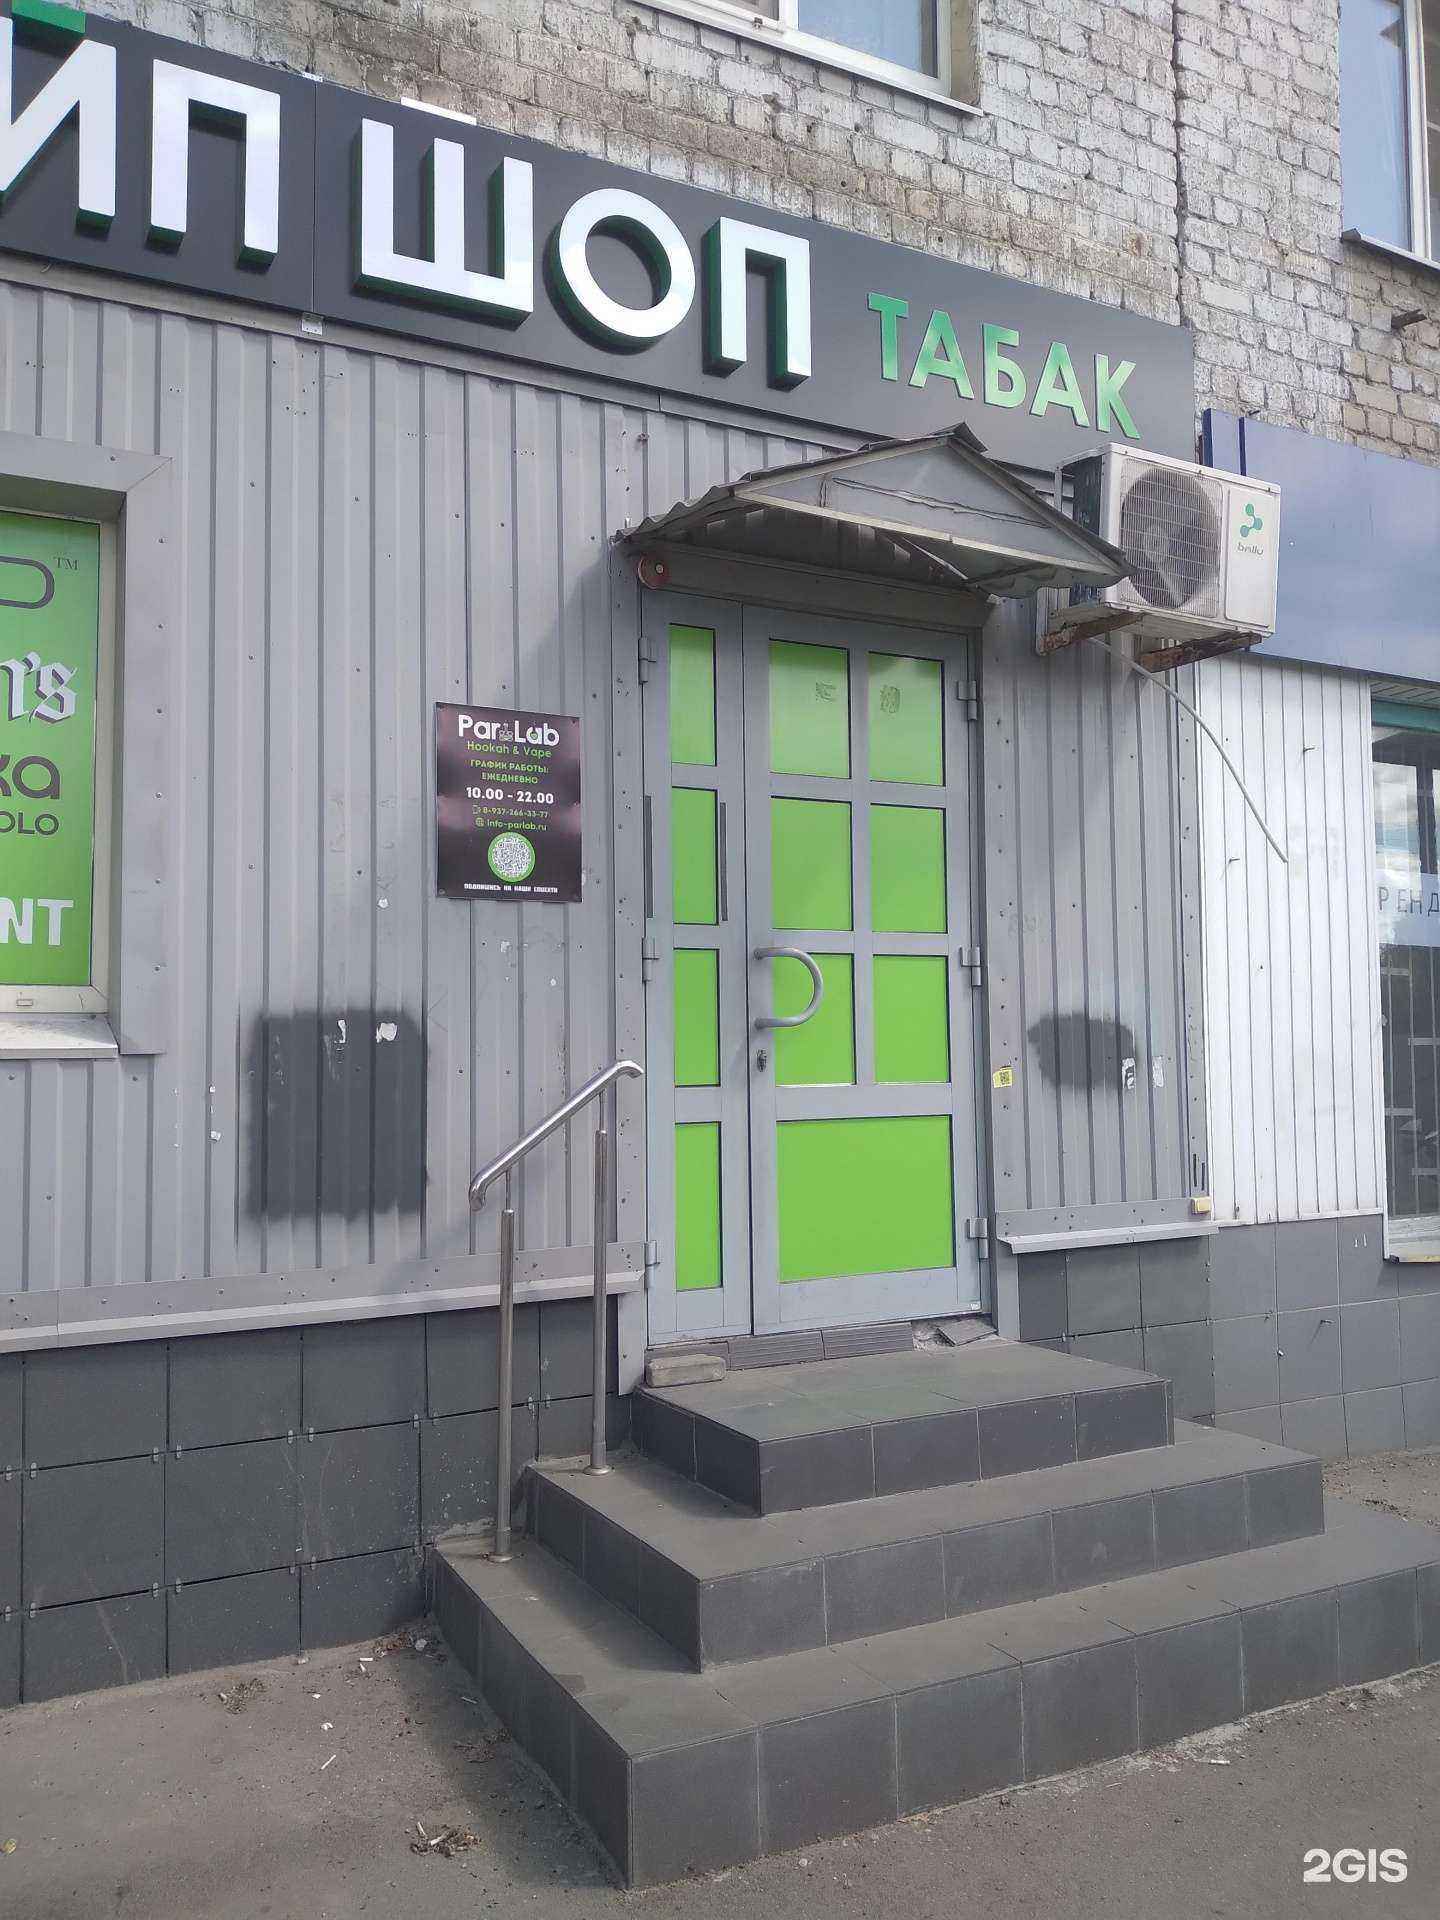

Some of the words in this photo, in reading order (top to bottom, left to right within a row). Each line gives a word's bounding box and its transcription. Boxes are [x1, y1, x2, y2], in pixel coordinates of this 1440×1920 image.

[357, 117, 812, 384] ШОП
[867, 292, 1141, 440] ТАБАК
[467, 741, 510, 755] Hookah
[512, 744, 521, 755] &
[523, 745, 553, 759] Vape
[470, 759, 508, 770] ГРАФИК
[481, 771, 538, 784] ЕЖЕДНЕВНО
[466, 786, 504, 800] 10.00
[516, 790, 554, 804] 22.00
